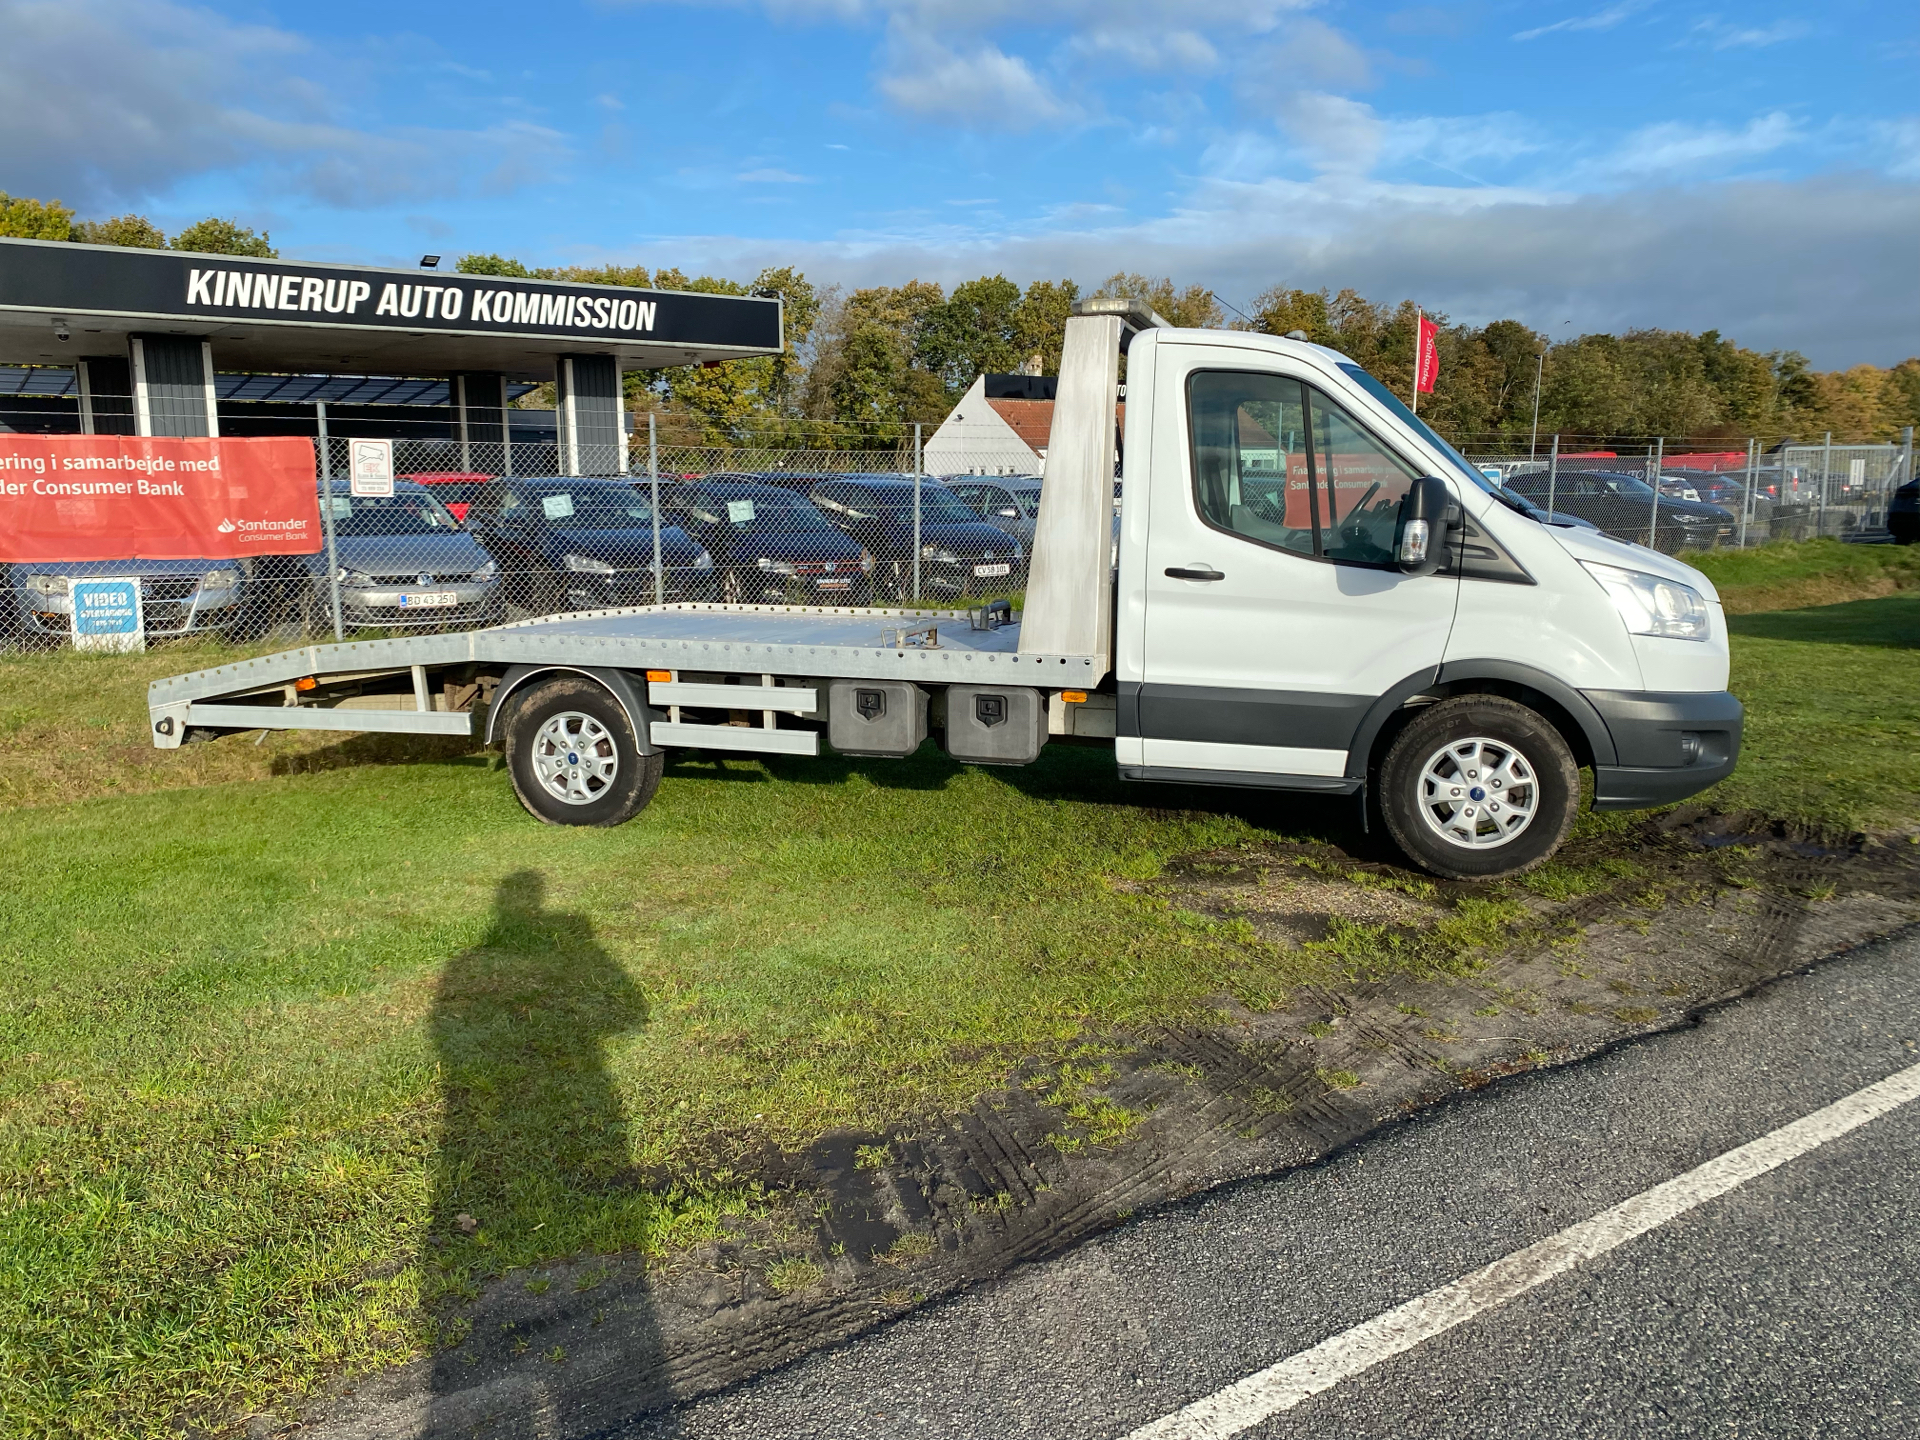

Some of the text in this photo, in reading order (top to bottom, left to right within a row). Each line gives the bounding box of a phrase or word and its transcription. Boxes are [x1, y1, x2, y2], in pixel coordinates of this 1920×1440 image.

[187, 269, 657, 332] KINNERUP AUTO KOMMISSION
[1421, 336, 1434, 386] Santander
[51, 453, 57, 470] i
[63, 454, 176, 475] samarbejde
[180, 456, 220, 472] med
[1293, 465, 1338, 477] Finaierg
[32, 479, 134, 496] Consumer
[138, 479, 185, 496] Bank
[1333, 479, 1370, 489] Consumer
[237, 518, 308, 532] Santander
[238, 531, 308, 542] Consumer Bank
[83, 592, 128, 607] VIDEO
